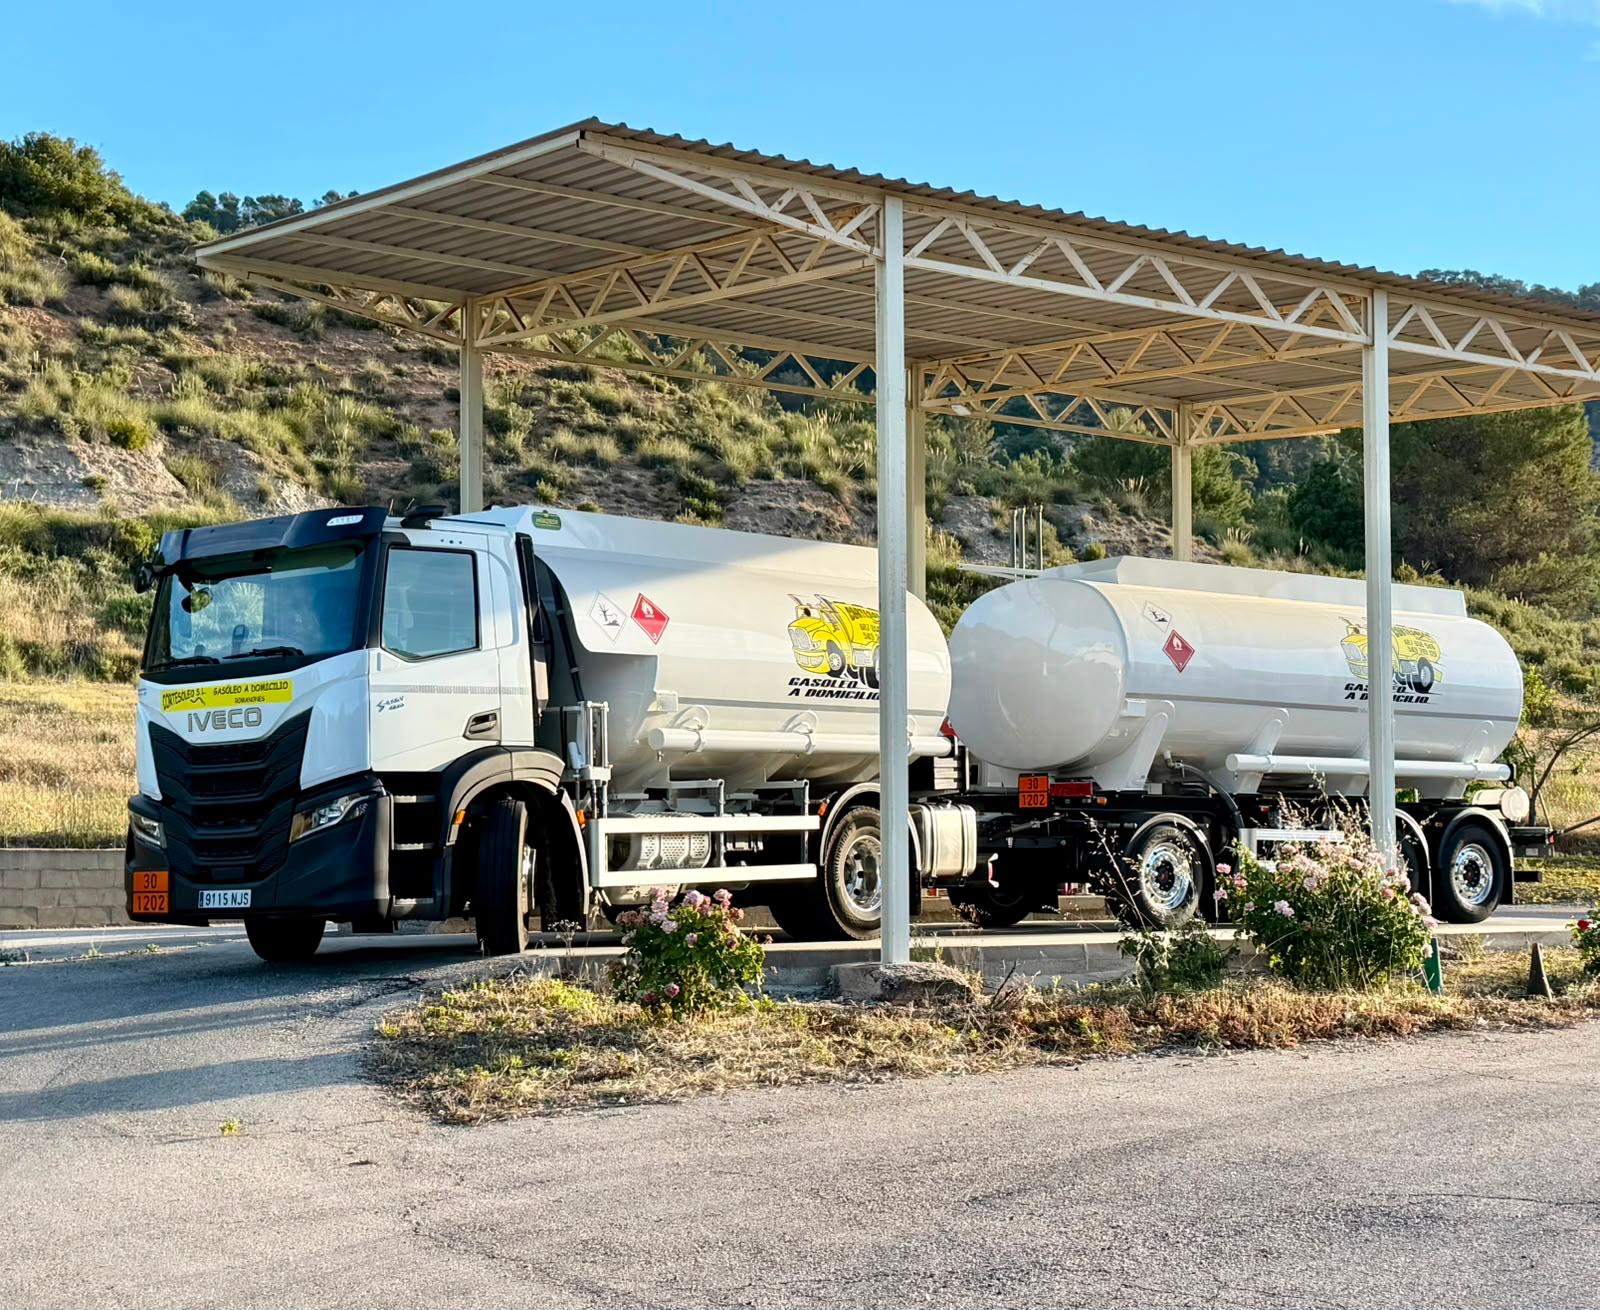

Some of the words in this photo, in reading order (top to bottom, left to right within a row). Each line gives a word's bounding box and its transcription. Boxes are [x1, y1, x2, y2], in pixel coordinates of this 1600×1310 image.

[251, 681, 289, 692] DOMICILIO
[788, 677, 858, 688] GASOLEO
[788, 688, 801, 697] A
[1344, 692, 1356, 700] A
[1360, 692, 1430, 704] DICILIO
[187, 707, 262, 732] IVECO
[1027, 778, 1039, 790] 30
[1022, 794, 1046, 806] 1202
[143, 873, 157, 889] 30
[137, 894, 165, 911] 1202
[205, 893, 229, 906] 9115
[231, 892, 249, 906] NJS
